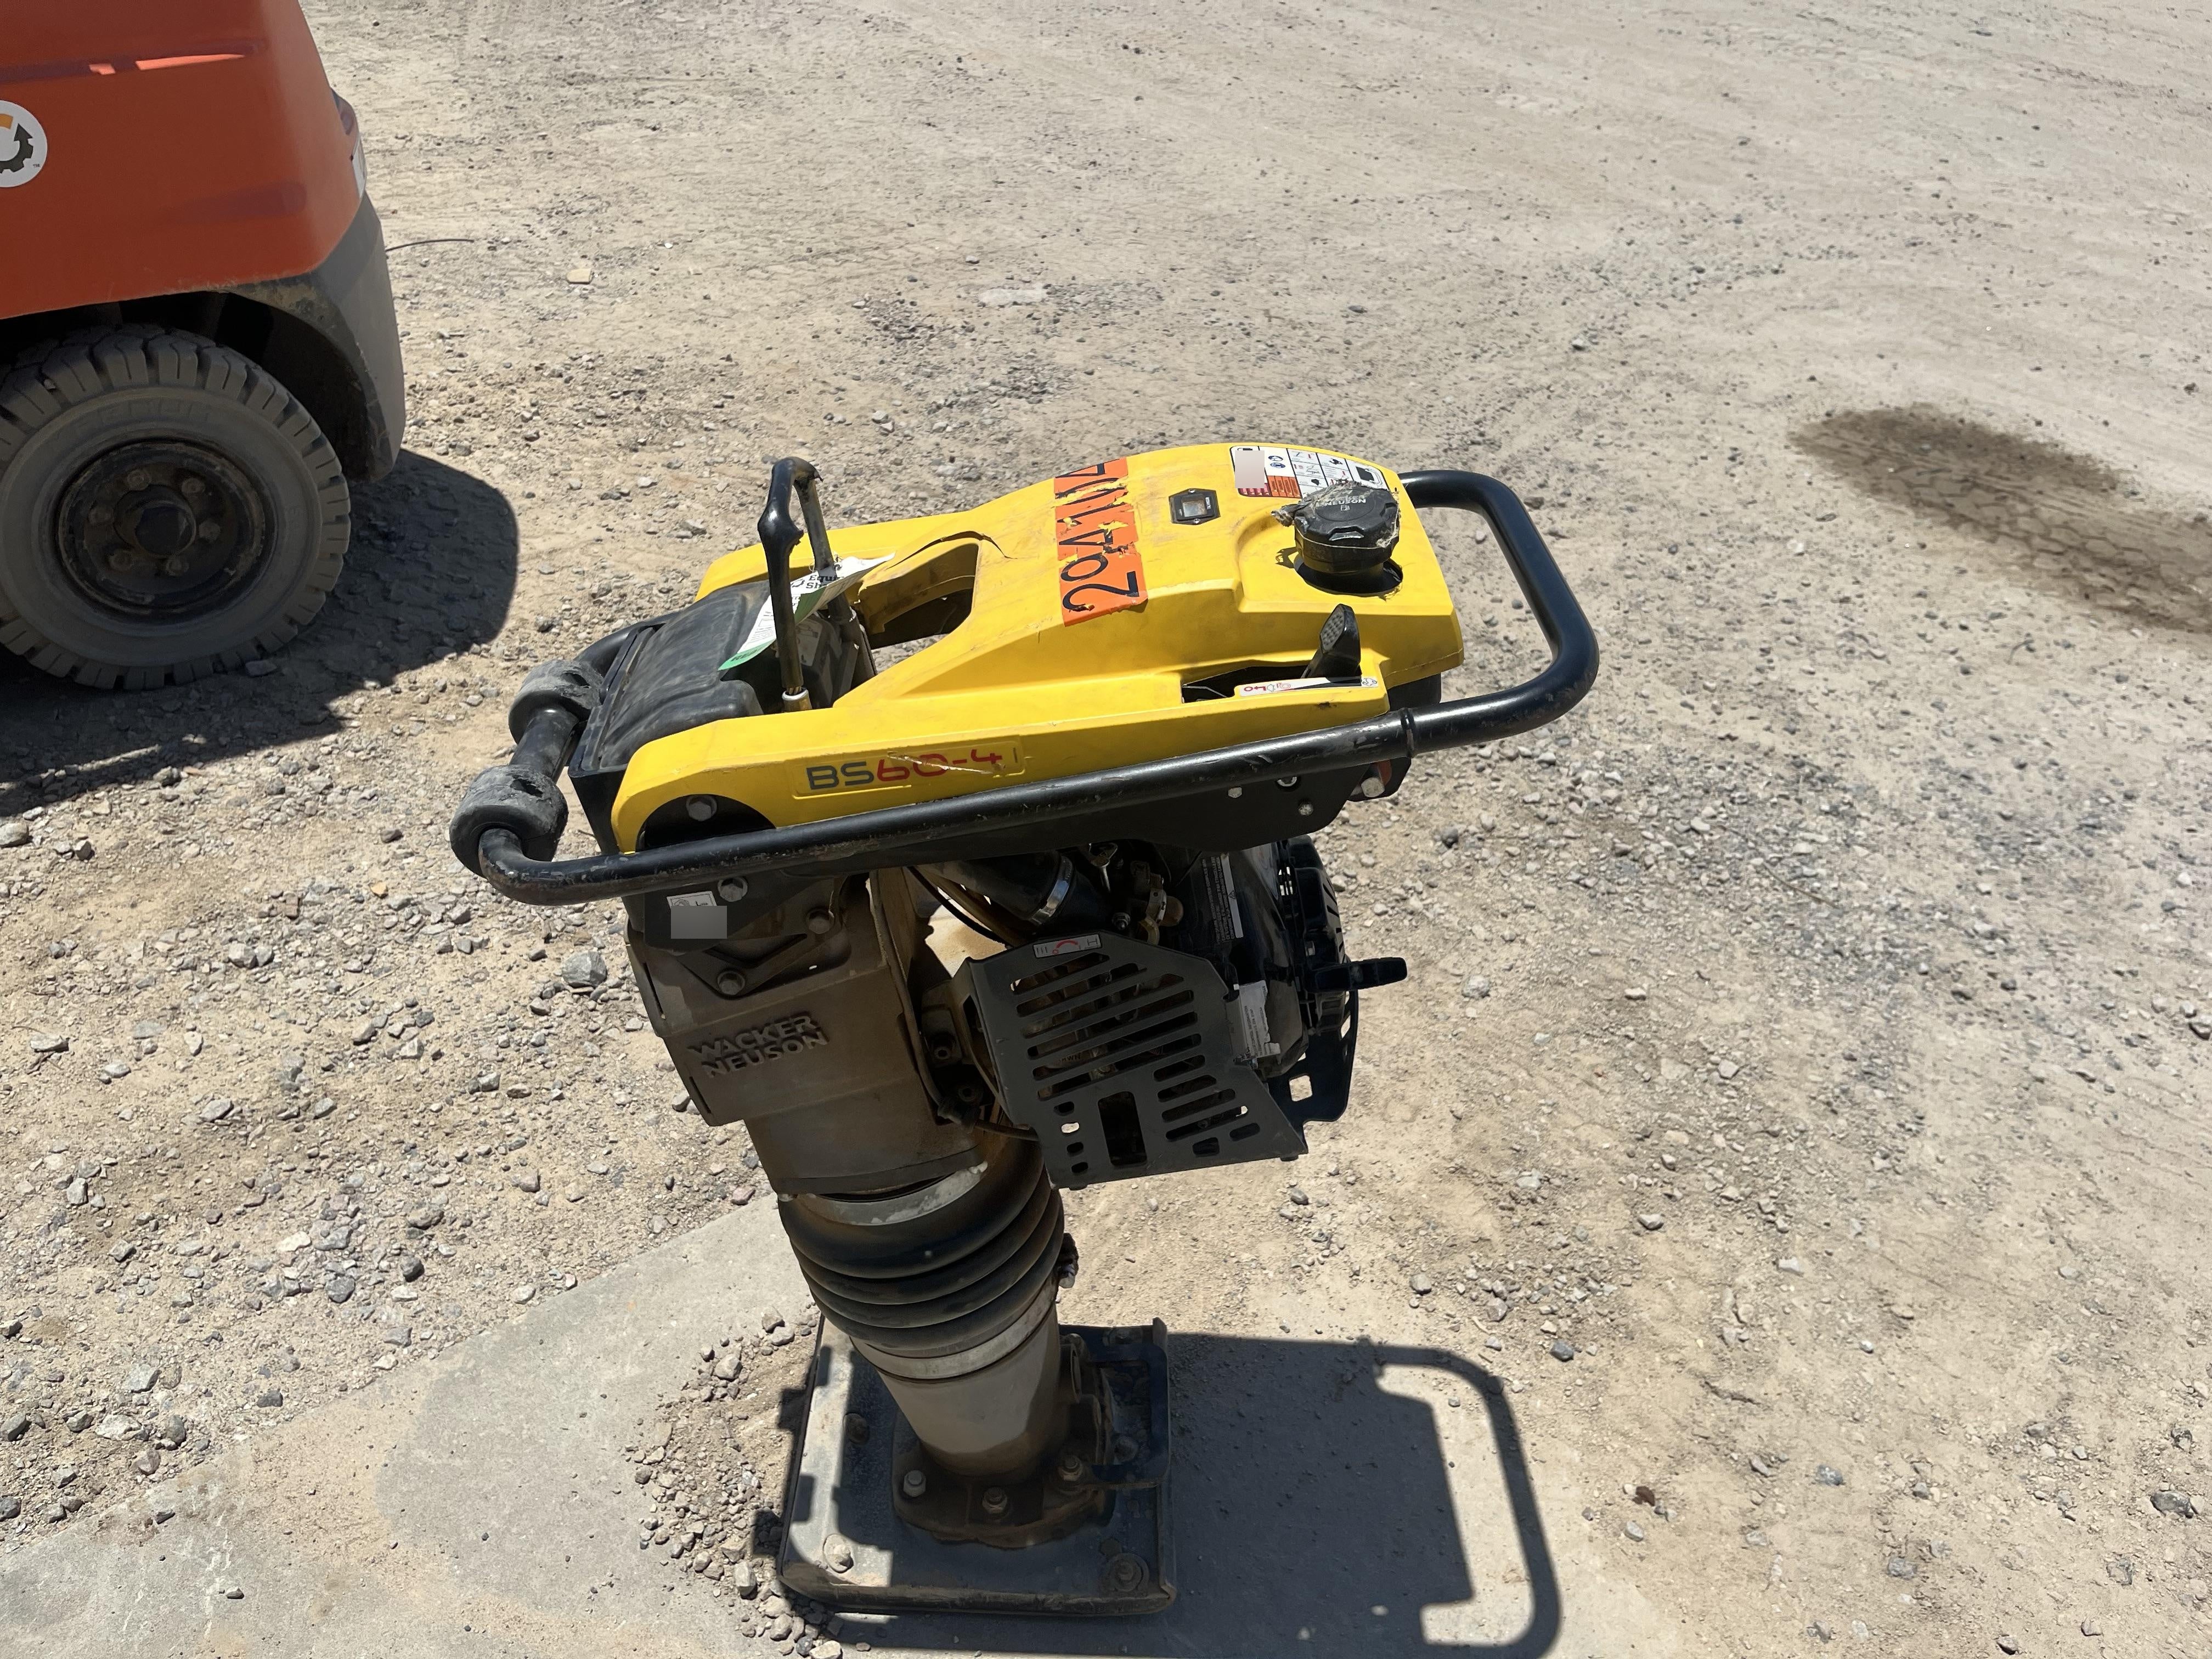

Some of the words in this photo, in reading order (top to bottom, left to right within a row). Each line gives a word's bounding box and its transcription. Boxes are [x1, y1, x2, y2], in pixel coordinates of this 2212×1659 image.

[806, 749, 1003, 790] BS60-4
[687, 1012, 818, 1058] WACKER
[701, 1030, 830, 1078] NEUSON
